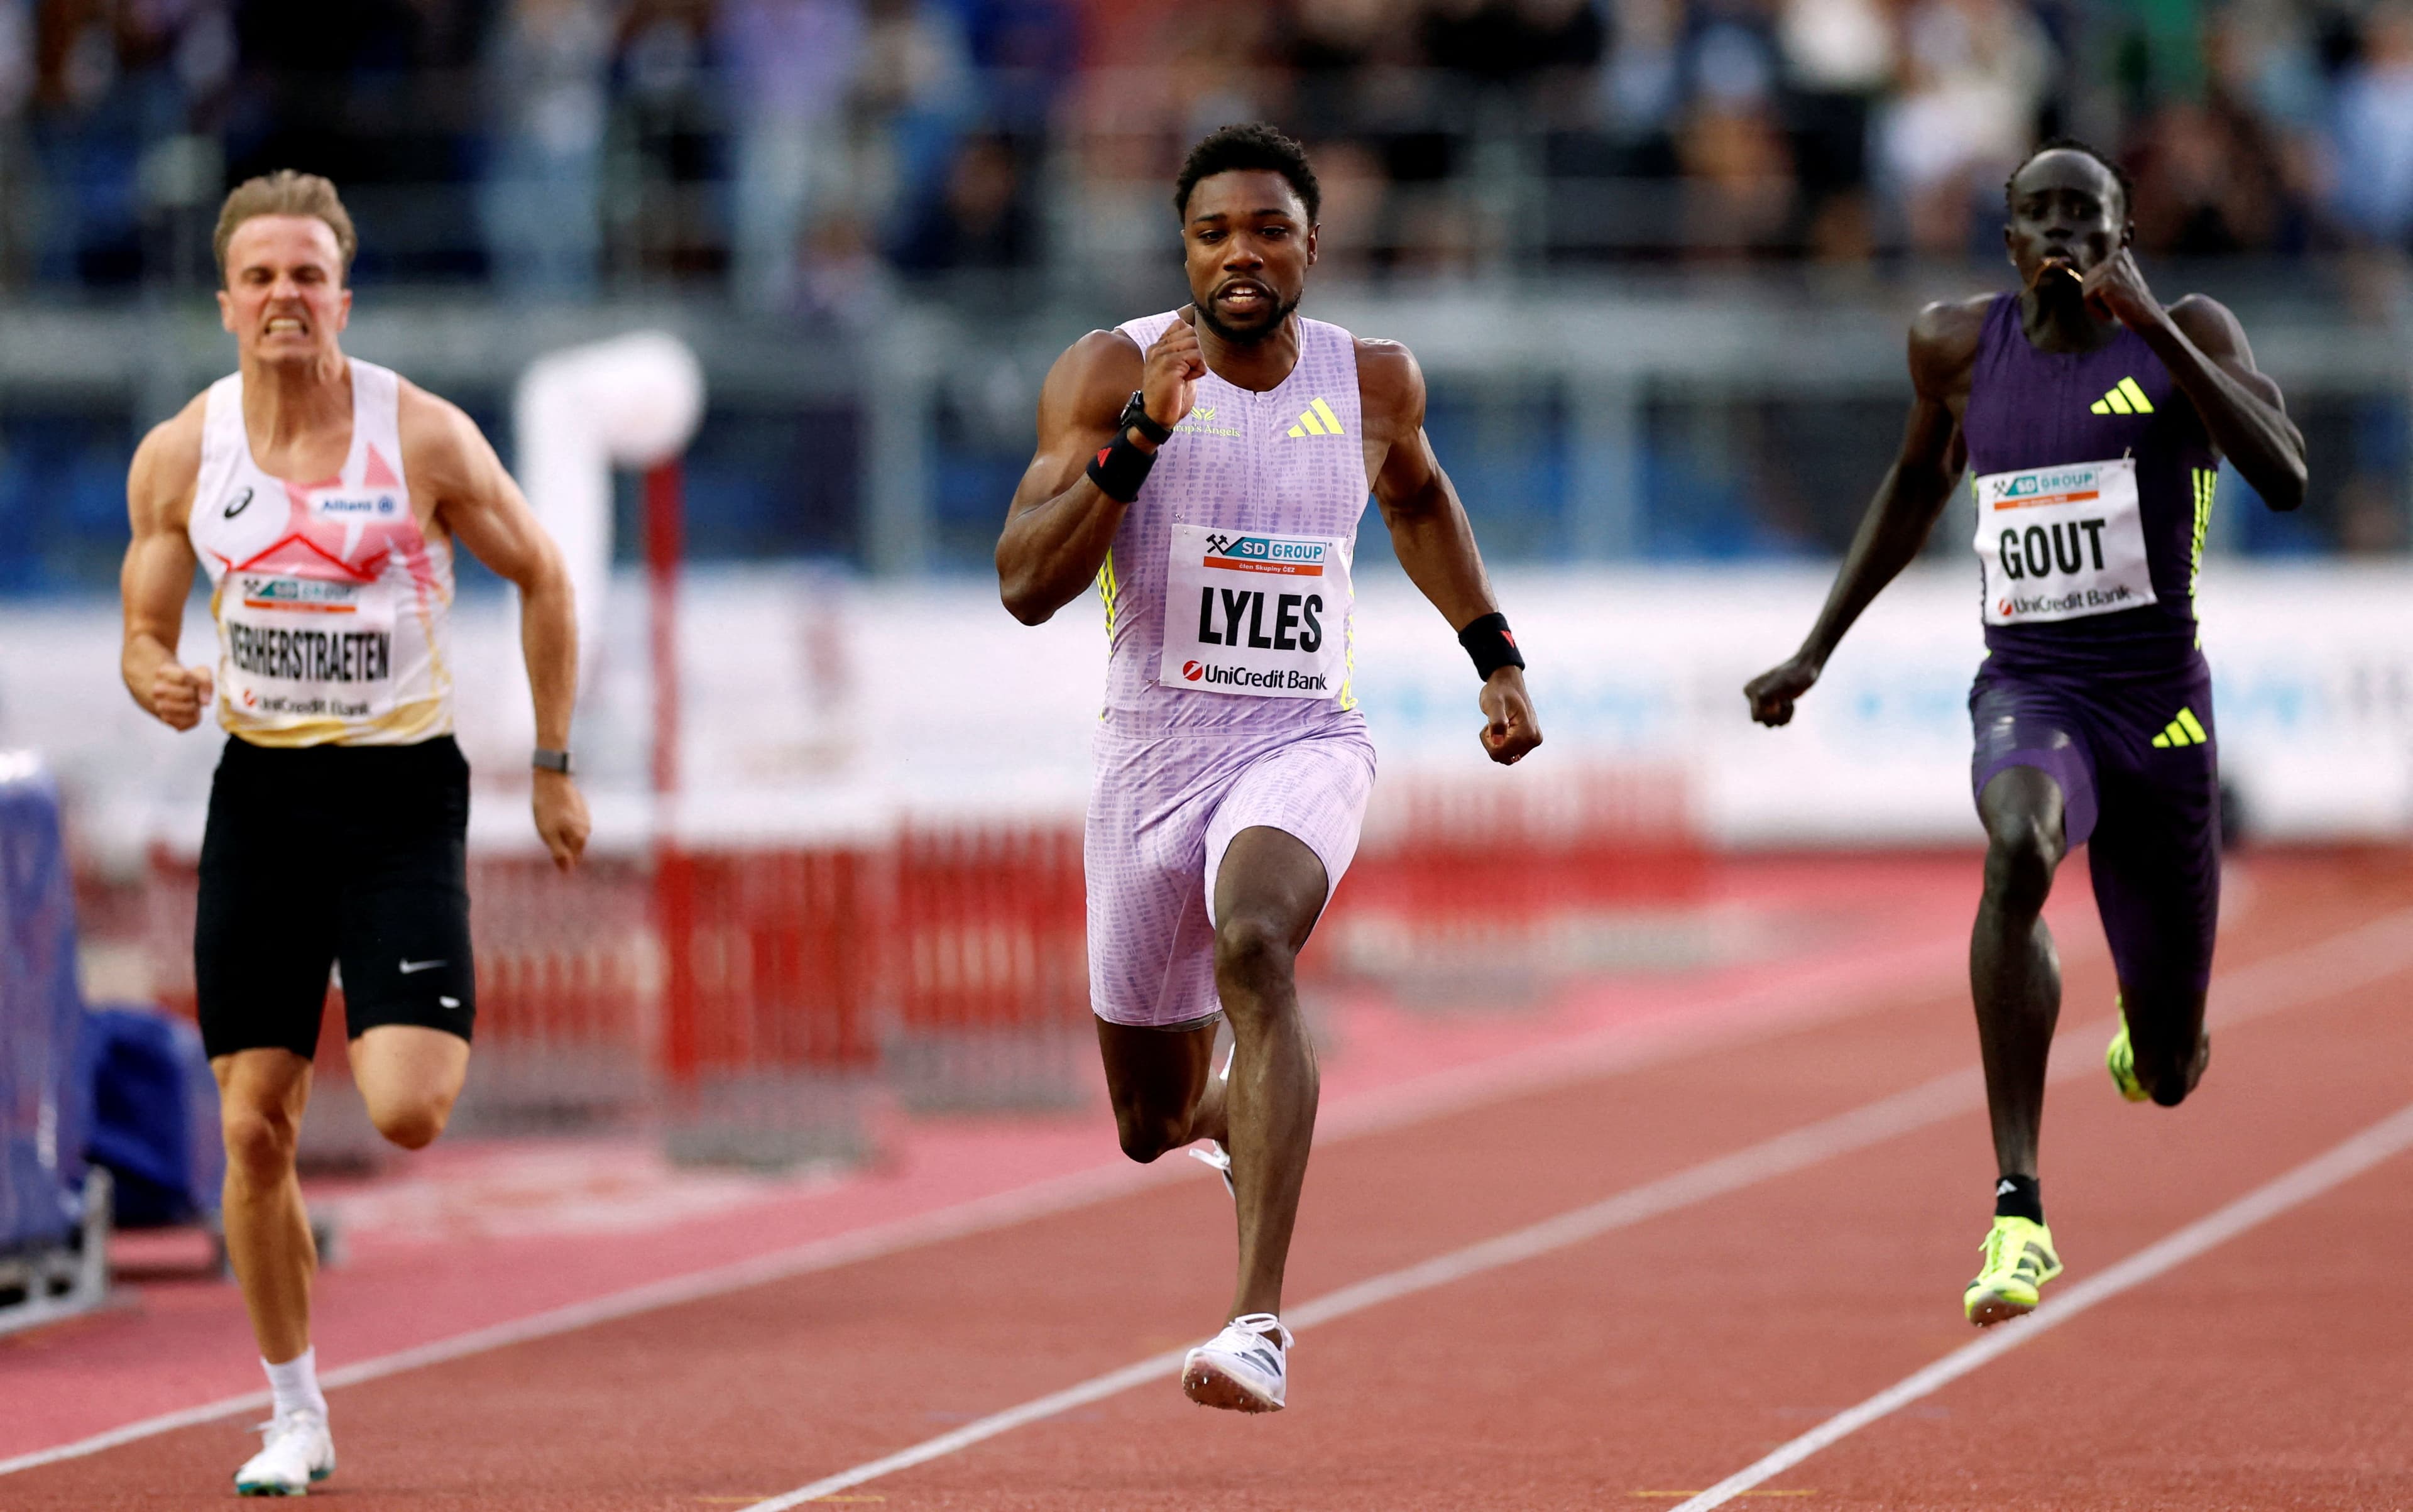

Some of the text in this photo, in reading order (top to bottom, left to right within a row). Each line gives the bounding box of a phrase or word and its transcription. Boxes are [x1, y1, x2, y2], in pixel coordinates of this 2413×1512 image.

[1205, 424, 1241, 438] Angels
[2041, 473, 2093, 489] GROUP
[1241, 541, 1323, 559] SD GROUP
[2000, 518, 2105, 579] GOUT
[1256, 564, 1281, 573] Skupiny
[2014, 585, 2131, 613] UniCredit Bank
[1198, 586, 1323, 653] LYLES
[1205, 664, 1328, 691] UniCredit Bank
